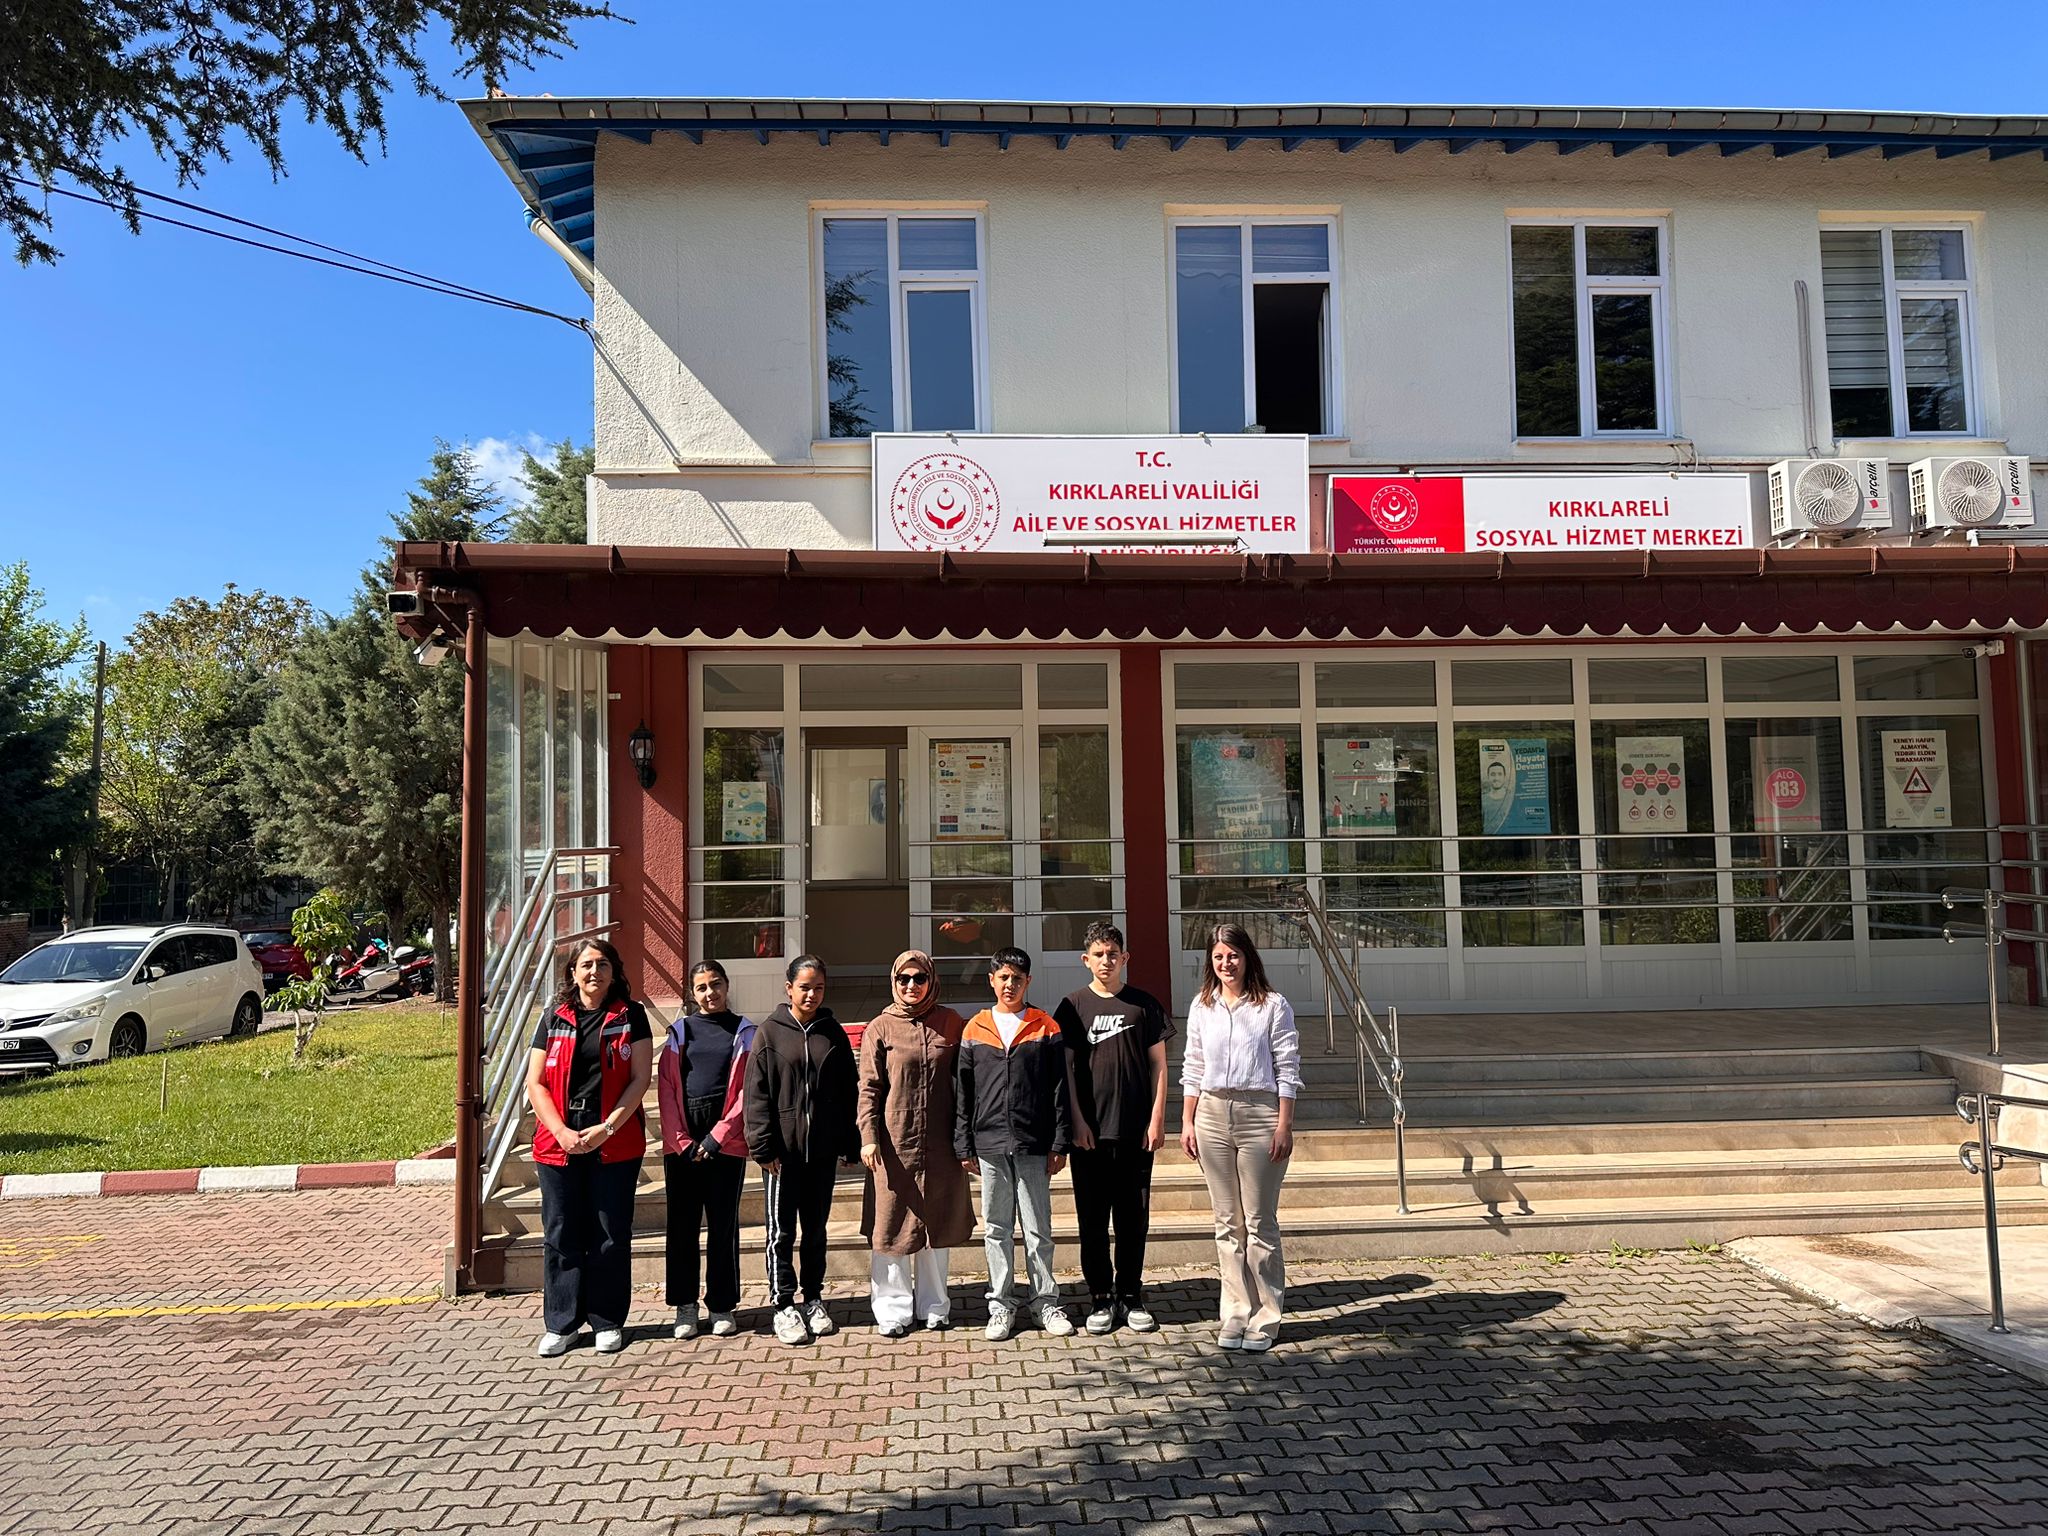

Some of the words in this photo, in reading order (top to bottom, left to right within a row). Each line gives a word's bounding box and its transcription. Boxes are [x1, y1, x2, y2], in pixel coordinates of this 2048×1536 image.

[1136, 451, 1172, 467] T.C.
[924, 473, 936, 484] AİLE
[946, 472, 968, 486] SOSYAL
[967, 483, 981, 516] HİZMETLER
[1049, 480, 1168, 500] KIRKLARELİ
[1172, 480, 1259, 500] VALİLİĞİ
[1549, 496, 1669, 517] KIRKLARELİ
[1013, 512, 1058, 532] AİLE
[1062, 516, 1089, 531] VE
[1094, 516, 1174, 531] SOSYAL
[1180, 512, 1297, 532] HİZMETLER
[1354, 537, 1385, 545] TÜRKİYE
[1386, 536, 1437, 545] CUMHURİYETİ
[1476, 529, 1558, 546] SOSYAL
[1566, 525, 1646, 546] HİZMET
[1653, 525, 1743, 546] MERKEZİ
[1516, 754, 1545, 764] Hayata
[1516, 762, 1545, 770] Devam!
[1777, 771, 1794, 779] ALO
[1772, 781, 1799, 797] 183
[1092, 1015, 1125, 1032] NIKE
